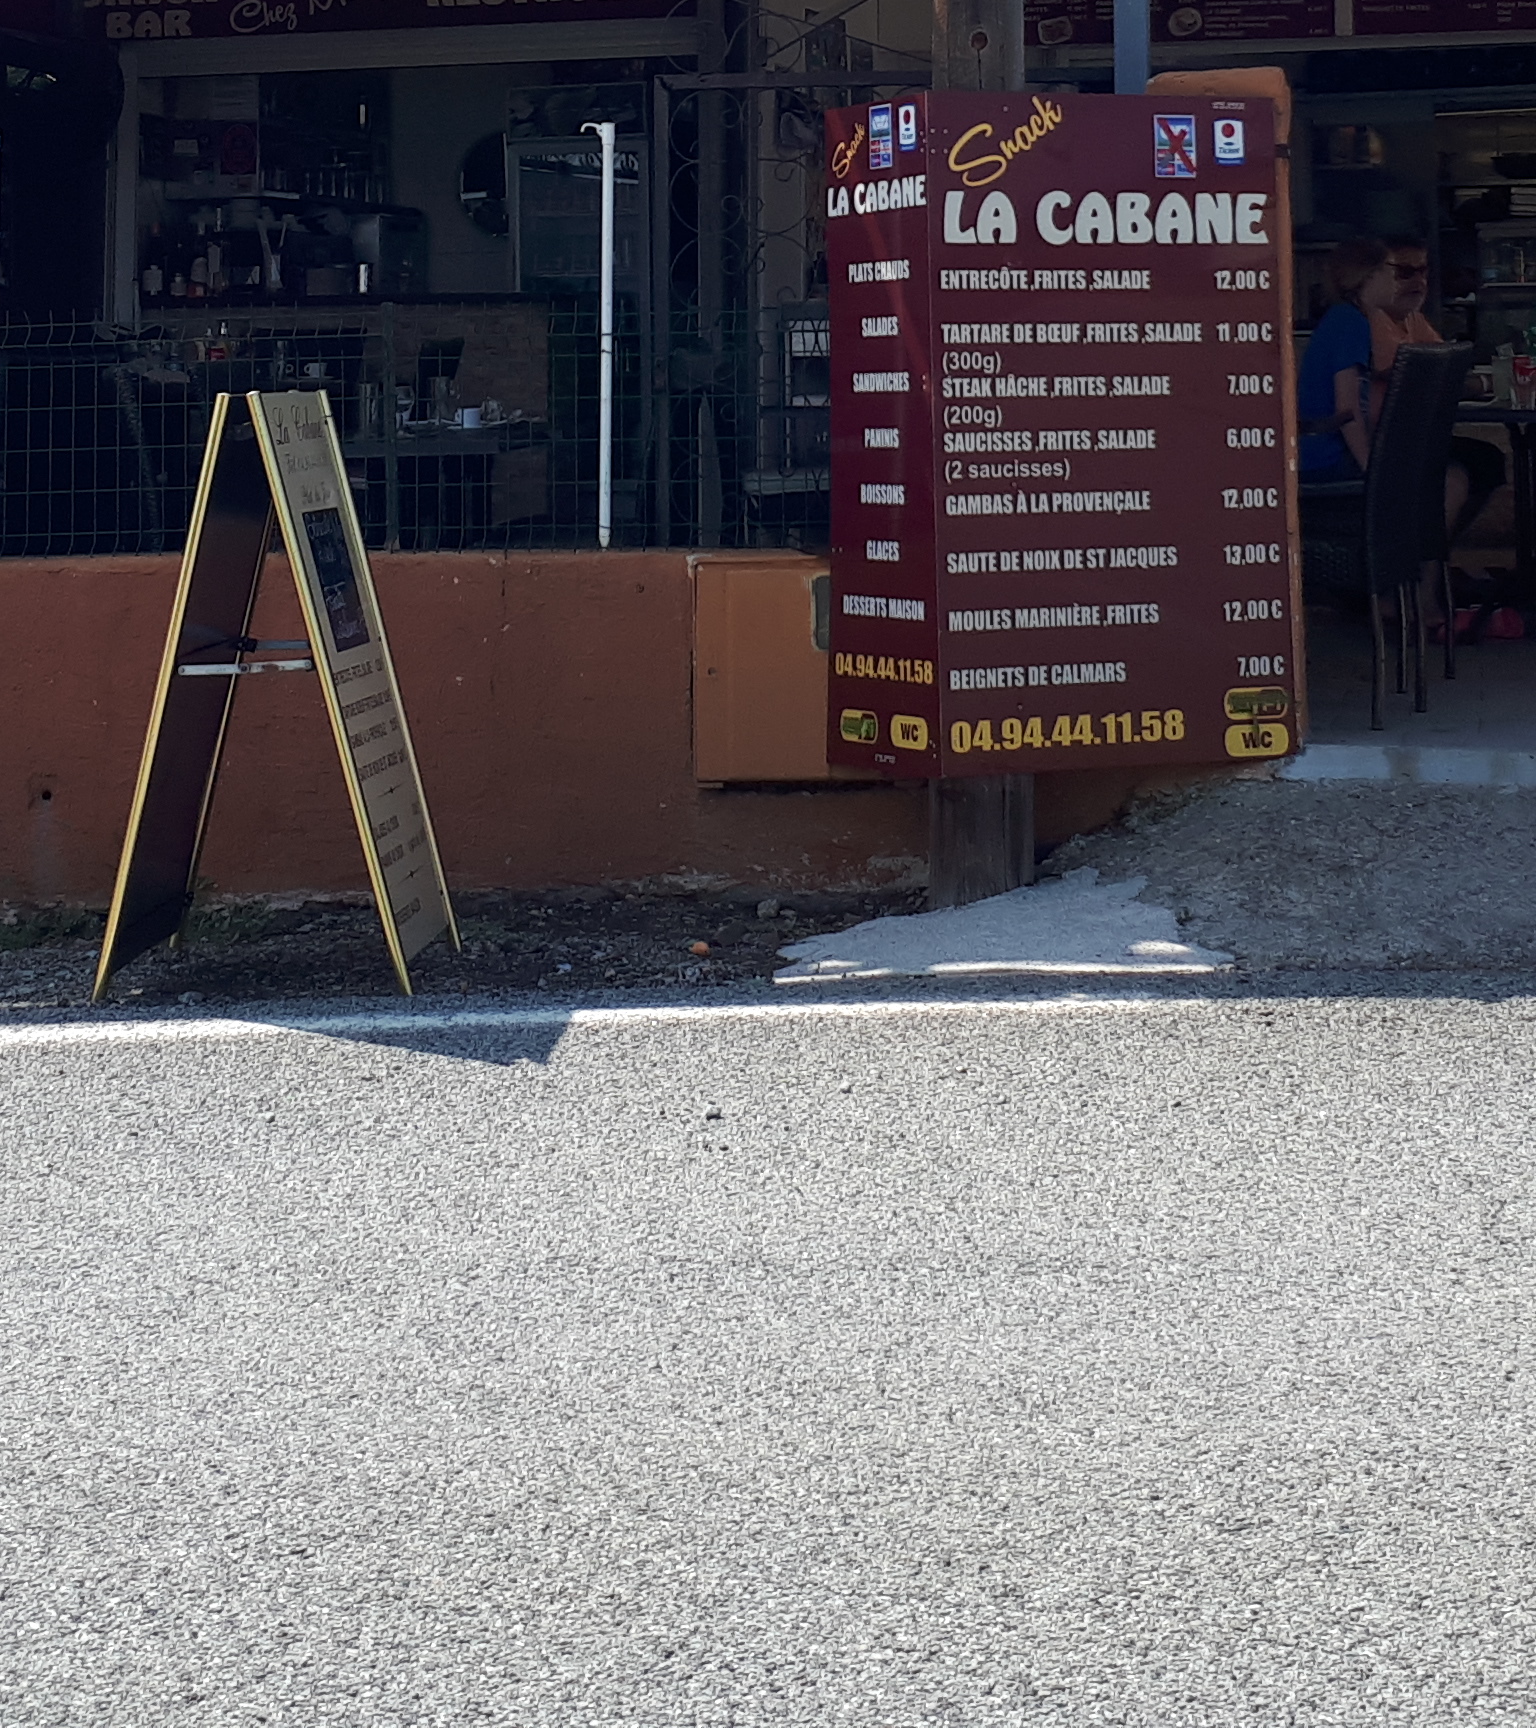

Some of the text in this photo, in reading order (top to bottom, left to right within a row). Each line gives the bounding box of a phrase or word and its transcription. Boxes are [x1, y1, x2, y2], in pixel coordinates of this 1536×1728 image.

[105, 9, 192, 39] BAR
[831, 121, 866, 179] Snack
[948, 95, 1064, 187] Snack
[827, 174, 927, 218] LA CABANE
[943, 189, 1269, 245] LA CABANE
[848, 259, 910, 283] PLATS CHAUDS
[861, 316, 898, 338] SALADES
[941, 323, 1010, 344] TARTARE
[1013, 323, 1033, 343] DE
[942, 351, 1002, 374] (300g)
[852, 371, 910, 393] SANDWICHES
[942, 376, 992, 398] STEAK
[943, 405, 1003, 429] (200g)
[864, 427, 899, 449] PANINIS
[943, 431, 1032, 453] SAUCISSES
[944, 458, 1071, 484] (2 saucisses)
[860, 483, 905, 505] BOISSONS
[945, 494, 1013, 516] GAMBAS
[1016, 489, 1028, 514] À
[1030, 493, 1050, 514] LA
[1052, 490, 1151, 516] PROVENÇALE
[866, 539, 900, 562] GLACES
[946, 552, 997, 574] SAUTE
[1000, 551, 1019, 571] DE
[1023, 549, 1061, 571] NOIX
[1064, 549, 1083, 569] DE
[1086, 548, 1106, 568] ST
[1109, 545, 1178, 569] JACQUES
[843, 594, 925, 621] DESSERTS MAISON
[948, 609, 1011, 632] MOULES
[1014, 603, 1101, 628] MARINIÈRE
[835, 651, 934, 684] 04.94.44.11.58
[949, 666, 1024, 690] BEIGNETS
[1028, 664, 1048, 685] DE
[1051, 661, 1126, 685] CALMARS
[900, 723, 918, 742] WC
[950, 709, 1185, 753] 04.94.44.11.58
[1242, 731, 1272, 749] WC
